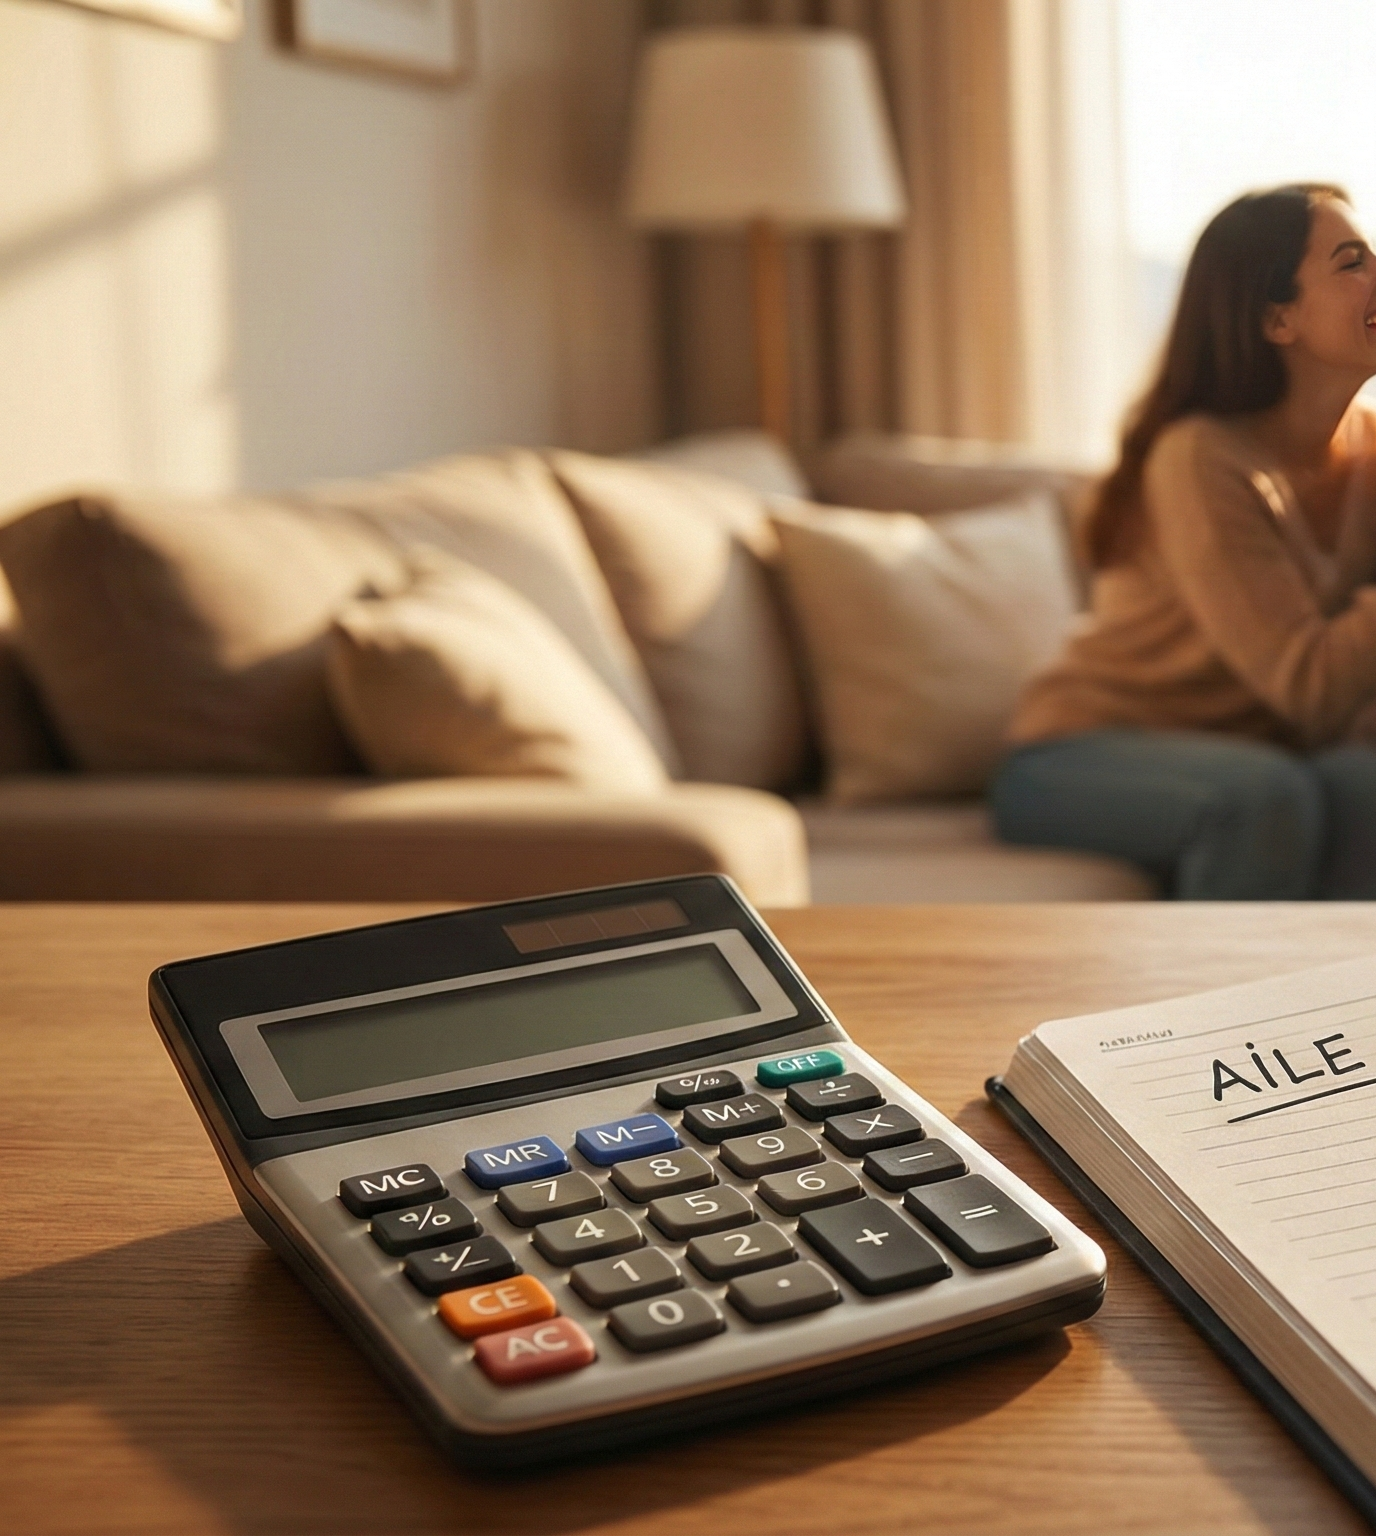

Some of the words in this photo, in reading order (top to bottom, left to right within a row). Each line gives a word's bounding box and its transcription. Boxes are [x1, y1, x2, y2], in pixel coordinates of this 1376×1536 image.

[776, 1053, 821, 1071] OFF
[1212, 1032, 1367, 1102] AİLE
[701, 1101, 761, 1123] M+
[482, 1143, 548, 1168] MR
[756, 1136, 785, 1155] 9
[649, 1158, 681, 1178] 8
[359, 1169, 426, 1195] MC
[531, 1180, 558, 1202] 7
[796, 1170, 826, 1191] 6
[684, 1194, 719, 1216] 5
[398, 1205, 451, 1231] %
[574, 1218, 606, 1239] 4
[723, 1233, 761, 1257] 2
[612, 1259, 641, 1282] 1
[468, 1285, 529, 1315] CE
[647, 1299, 685, 1326] 0
[506, 1325, 569, 1361] AC
